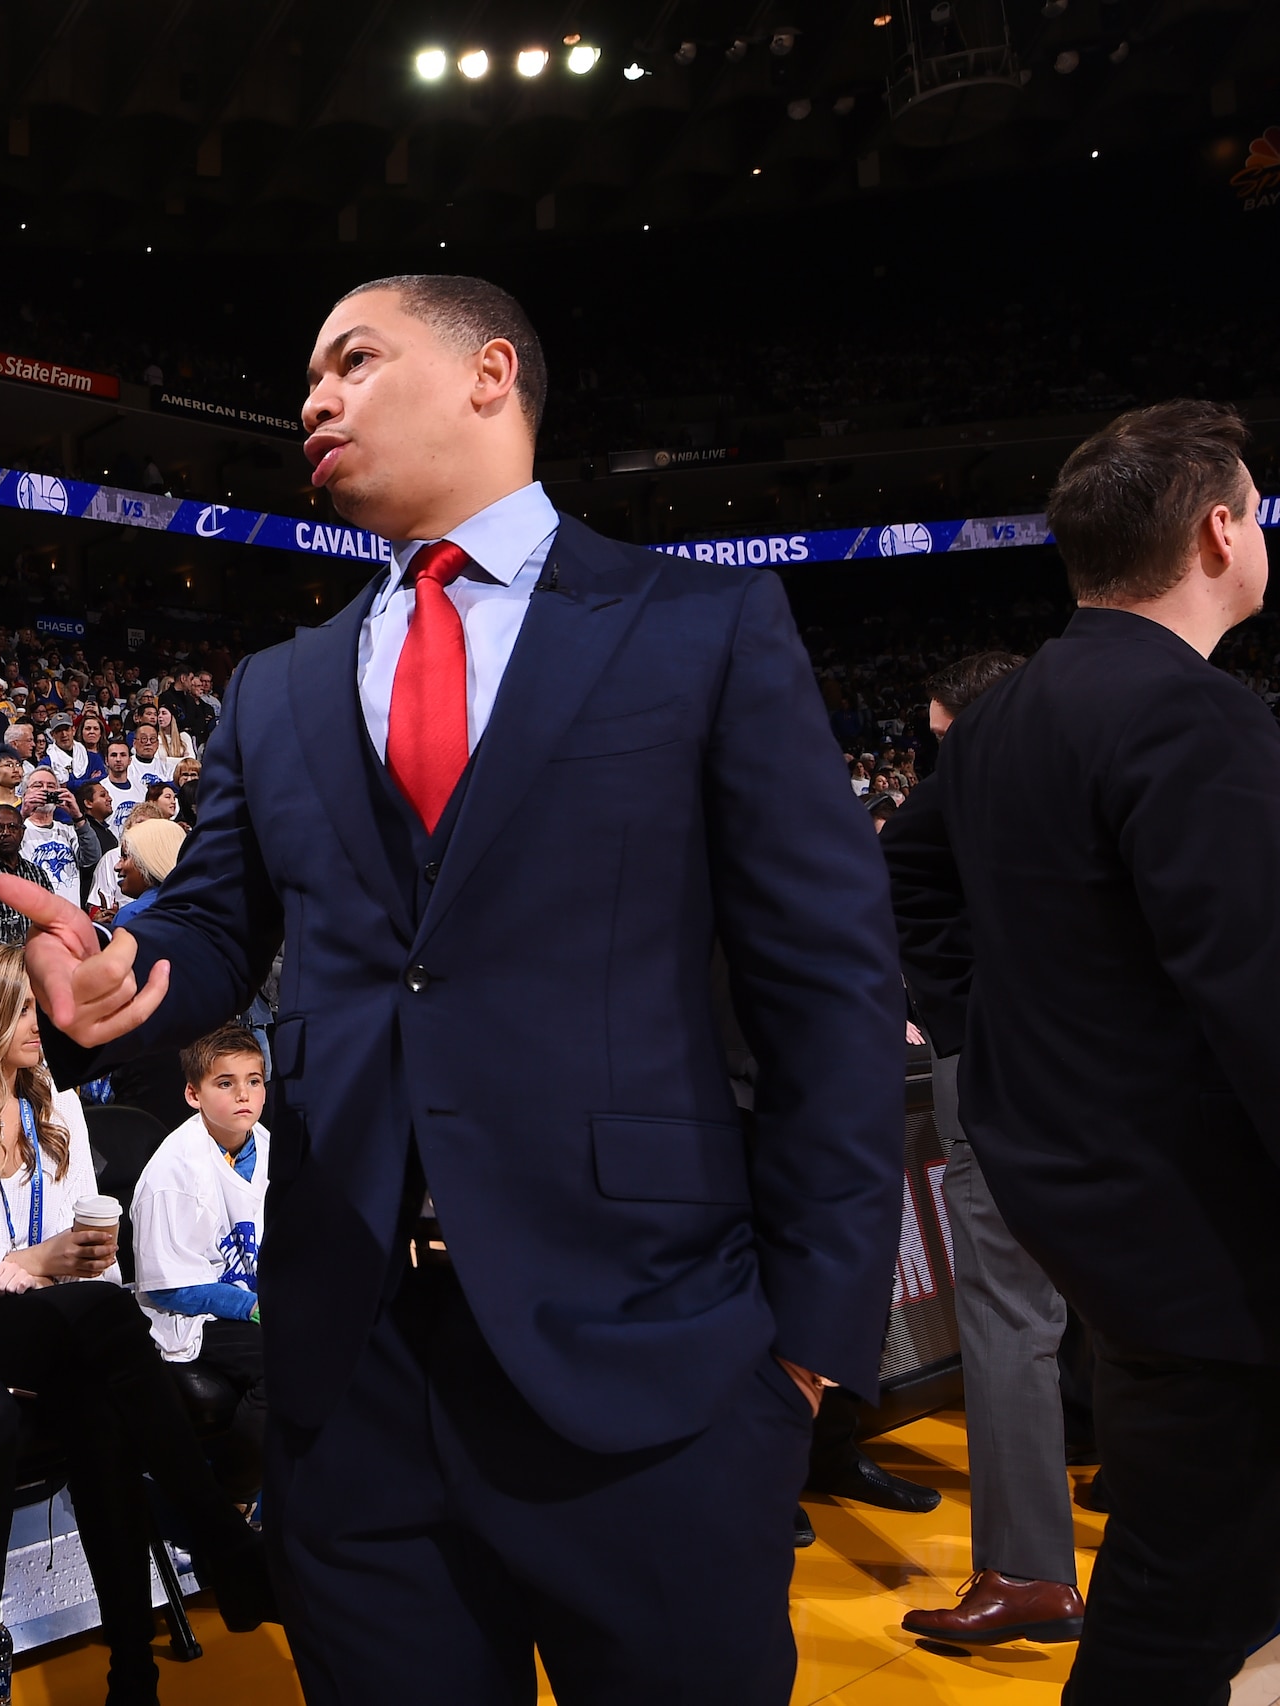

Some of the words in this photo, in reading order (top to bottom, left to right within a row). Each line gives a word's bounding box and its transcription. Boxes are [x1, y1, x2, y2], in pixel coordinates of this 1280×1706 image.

[160, 393, 236, 418] AMERICAN
[240, 410, 299, 431] EXPRESS
[677, 452, 699, 462] NBA
[702, 448, 726, 460] LIVE
[123, 499, 144, 518] VS
[992, 525, 1015, 540] VS
[36, 620, 74, 633] CHASE
